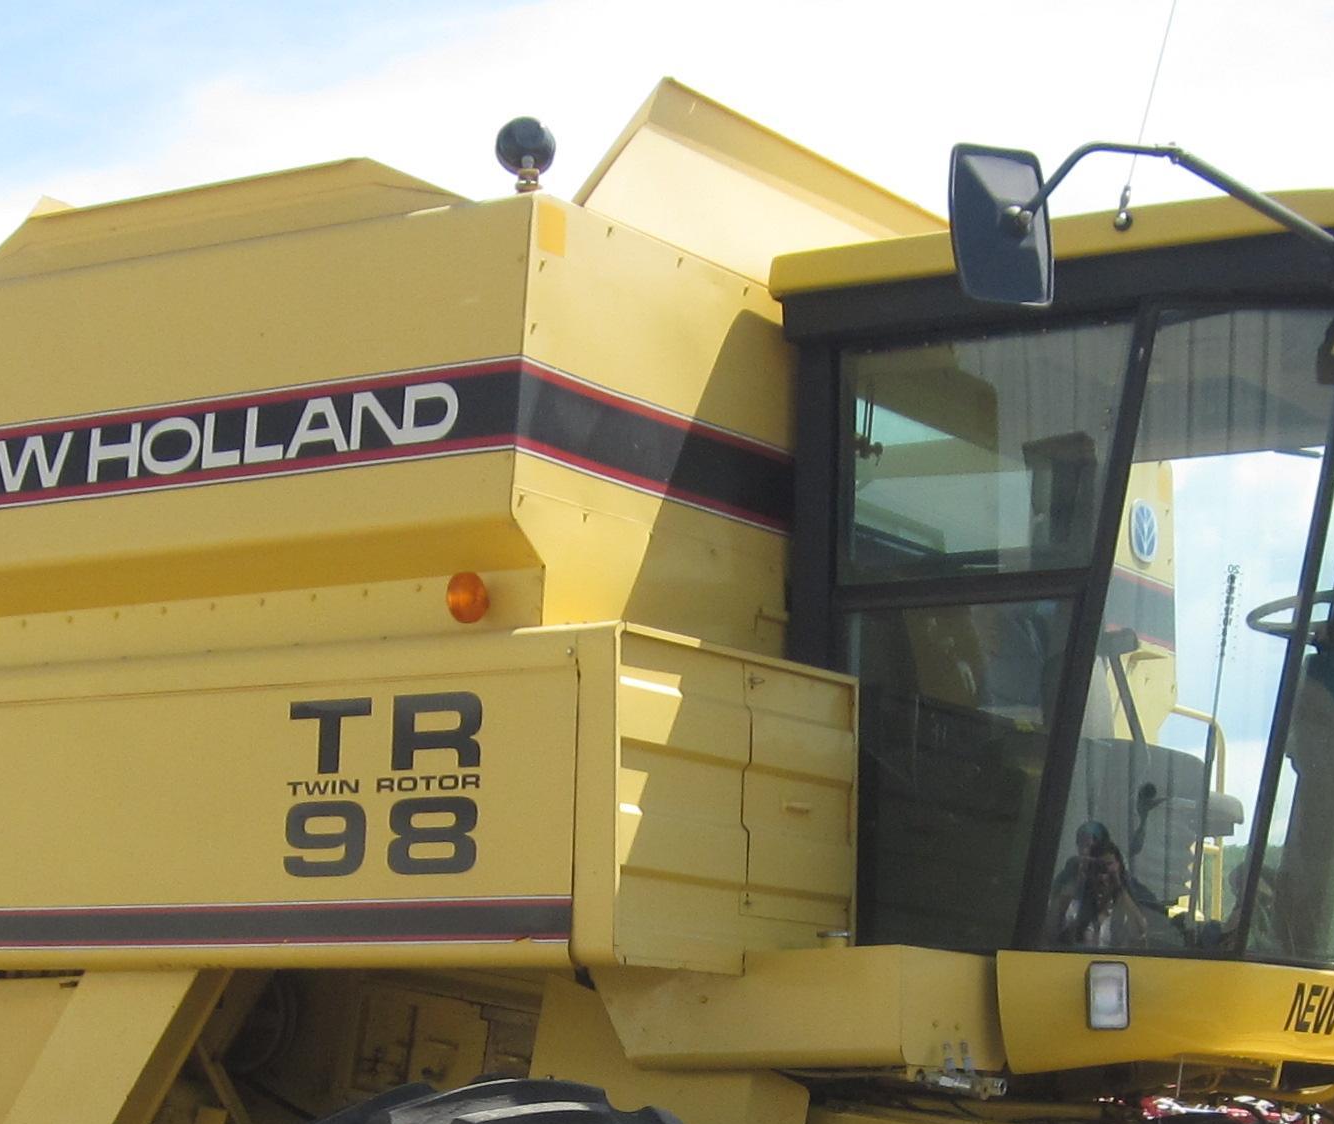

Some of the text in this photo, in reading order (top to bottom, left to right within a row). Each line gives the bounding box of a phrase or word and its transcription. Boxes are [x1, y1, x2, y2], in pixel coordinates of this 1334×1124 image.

[87, 382, 459, 484] HOLLAND
[290, 691, 482, 774] TR
[287, 774, 481, 796] TWIN ROTOR
[283, 796, 478, 877] 98
